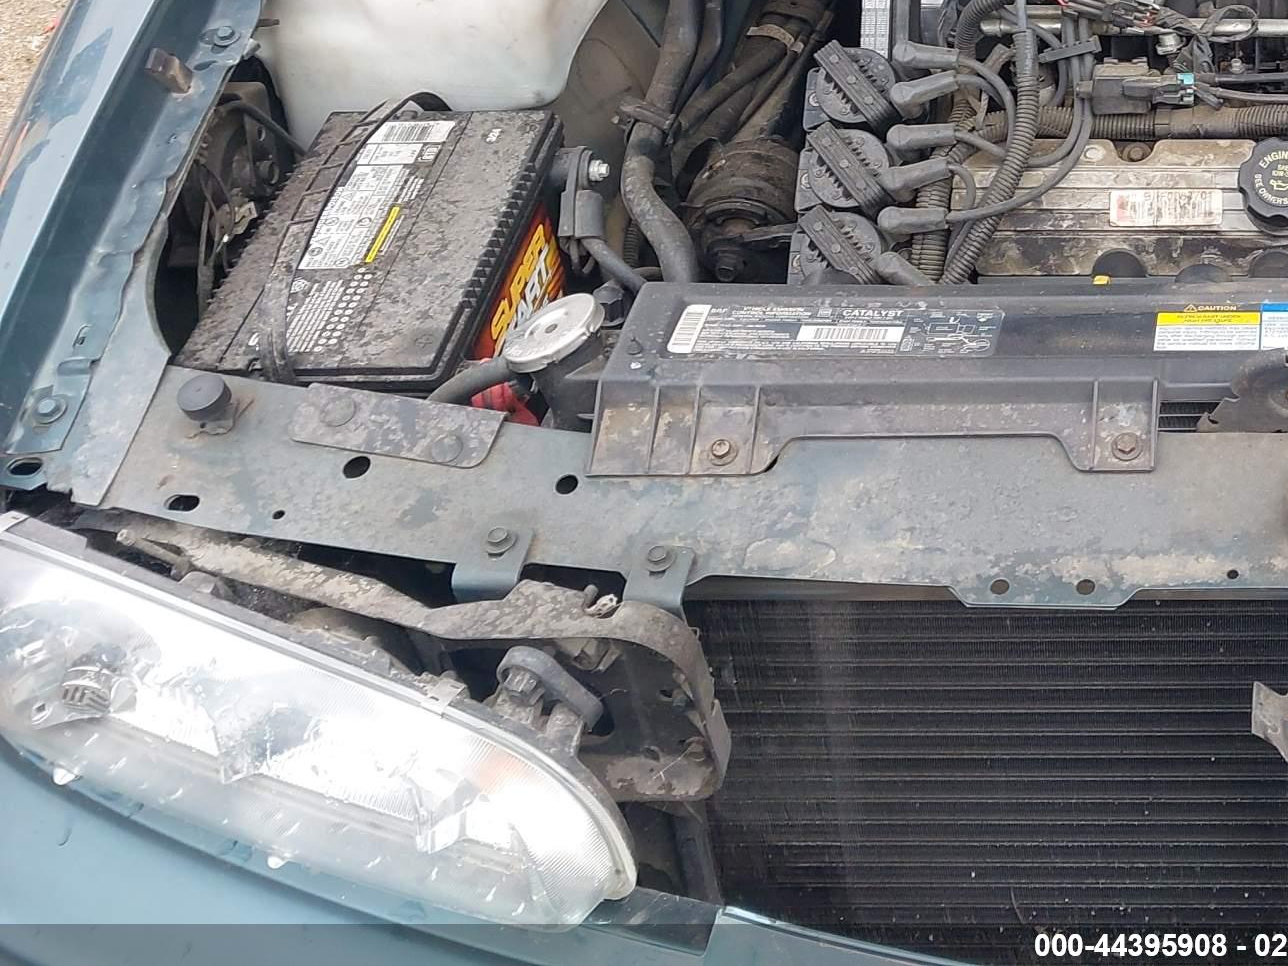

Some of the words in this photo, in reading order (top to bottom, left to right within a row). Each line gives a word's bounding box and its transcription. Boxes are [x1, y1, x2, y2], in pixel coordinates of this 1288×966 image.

[1254, 173, 1265, 188] SEE
[1258, 187, 1288, 205] OWNER'S
[490, 223, 546, 341] SUPER
[842, 309, 905, 317] CATALYST
